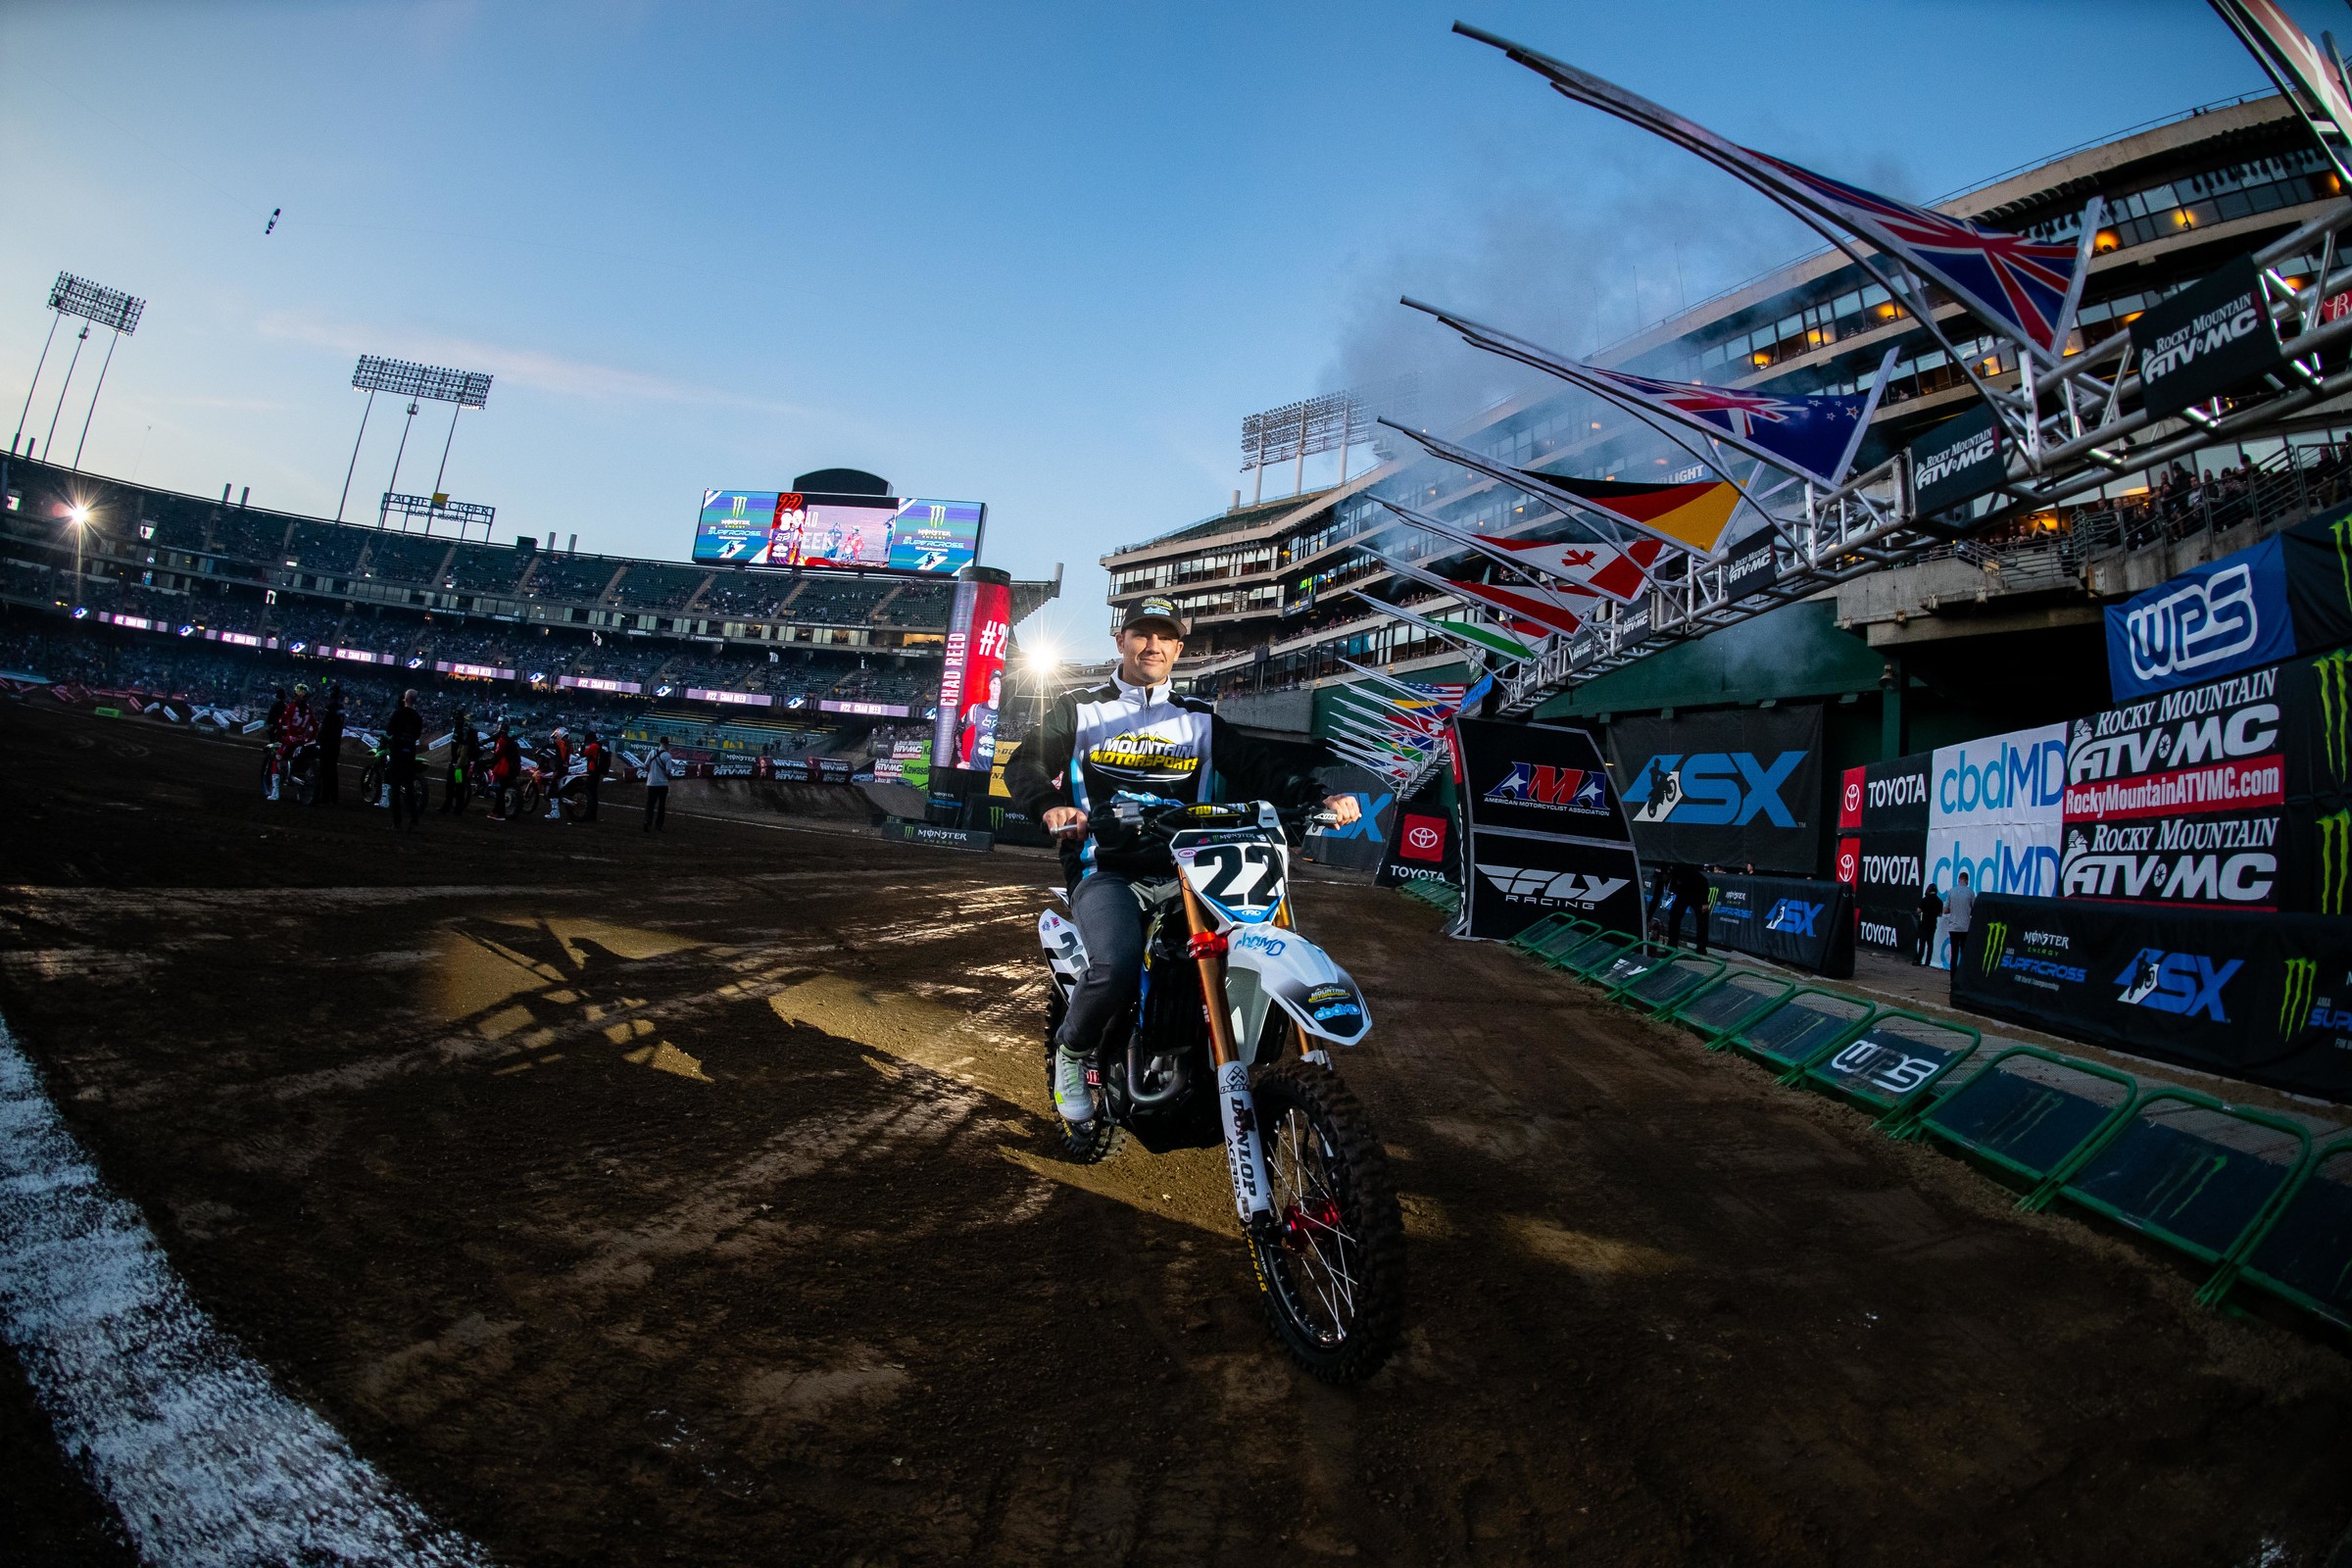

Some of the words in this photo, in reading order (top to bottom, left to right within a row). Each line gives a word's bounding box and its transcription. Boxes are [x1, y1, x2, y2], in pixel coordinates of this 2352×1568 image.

[2156, 324, 2191, 355] ROCKY
[2192, 292, 2252, 335] MOUNTAIN
[1927, 449, 1951, 468] ROCKY
[1951, 427, 1993, 457] MOUNTAIN
[1668, 465, 1704, 483] LIGHT
[2127, 563, 2258, 680] WPS
[945, 633, 966, 666] REED
[941, 671, 960, 707] CHAD
[2094, 701, 2157, 738] ROCKY
[2157, 667, 2280, 723] MOUNTAIN
[1102, 737, 1194, 760] MOUNTAIN
[1483, 760, 1611, 811] AMA
[1868, 772, 1927, 808] TOYOTA
[1939, 739, 2067, 814] cbdMD
[1484, 796, 1518, 807] AMERICAN
[1518, 801, 1568, 811] MOTORCYCLIST
[1568, 807, 1610, 817] ASSOCIATION
[2065, 766, 2280, 819] RockyMountainATVMC.com
[918, 828, 967, 841] MONSTER
[2090, 824, 2154, 853] ROCKY
[2155, 816, 2280, 851] MOUNTAIN
[1194, 845, 1284, 906] 22
[1390, 864, 1446, 883] TOYOTA
[1862, 856, 1920, 887] TOYOTA
[1505, 894, 1595, 910] RACING
[1861, 921, 1898, 948] TOYOTA
[2023, 930, 2070, 950] MONSTER
[2027, 947, 2060, 957] ENERGY
[2000, 955, 2088, 984] SUPERCROSS
[1311, 988, 1347, 998] MOUNTAIN
[1313, 1004, 1361, 1020] cbdMD
